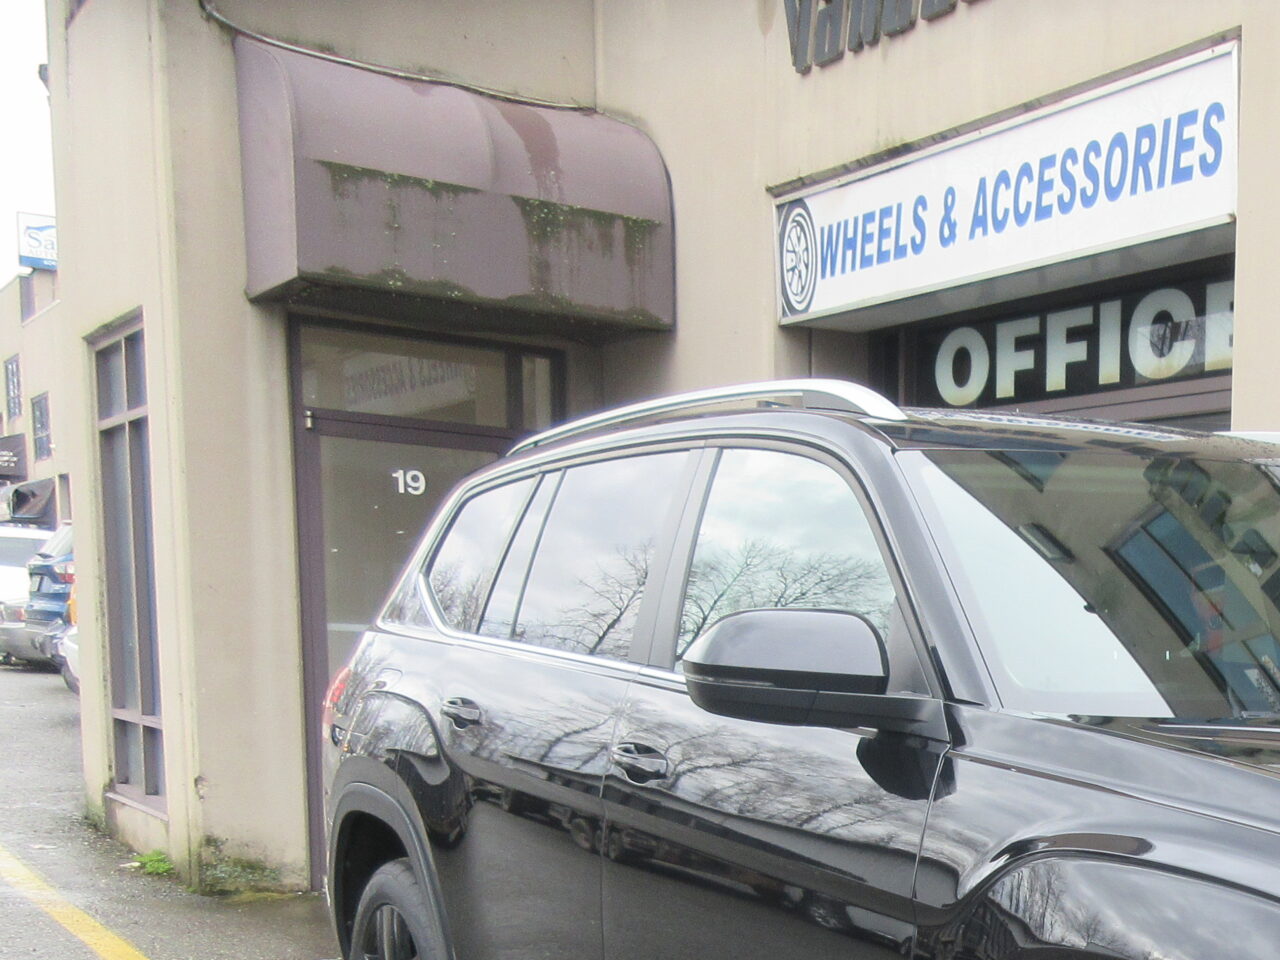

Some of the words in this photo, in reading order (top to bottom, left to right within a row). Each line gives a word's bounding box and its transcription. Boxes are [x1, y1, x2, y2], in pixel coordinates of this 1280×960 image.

[819, 194, 928, 281] WHEELS
[938, 185, 957, 249] &
[968, 101, 1226, 241] ACCESSORIES
[391, 469, 426, 495] 19
